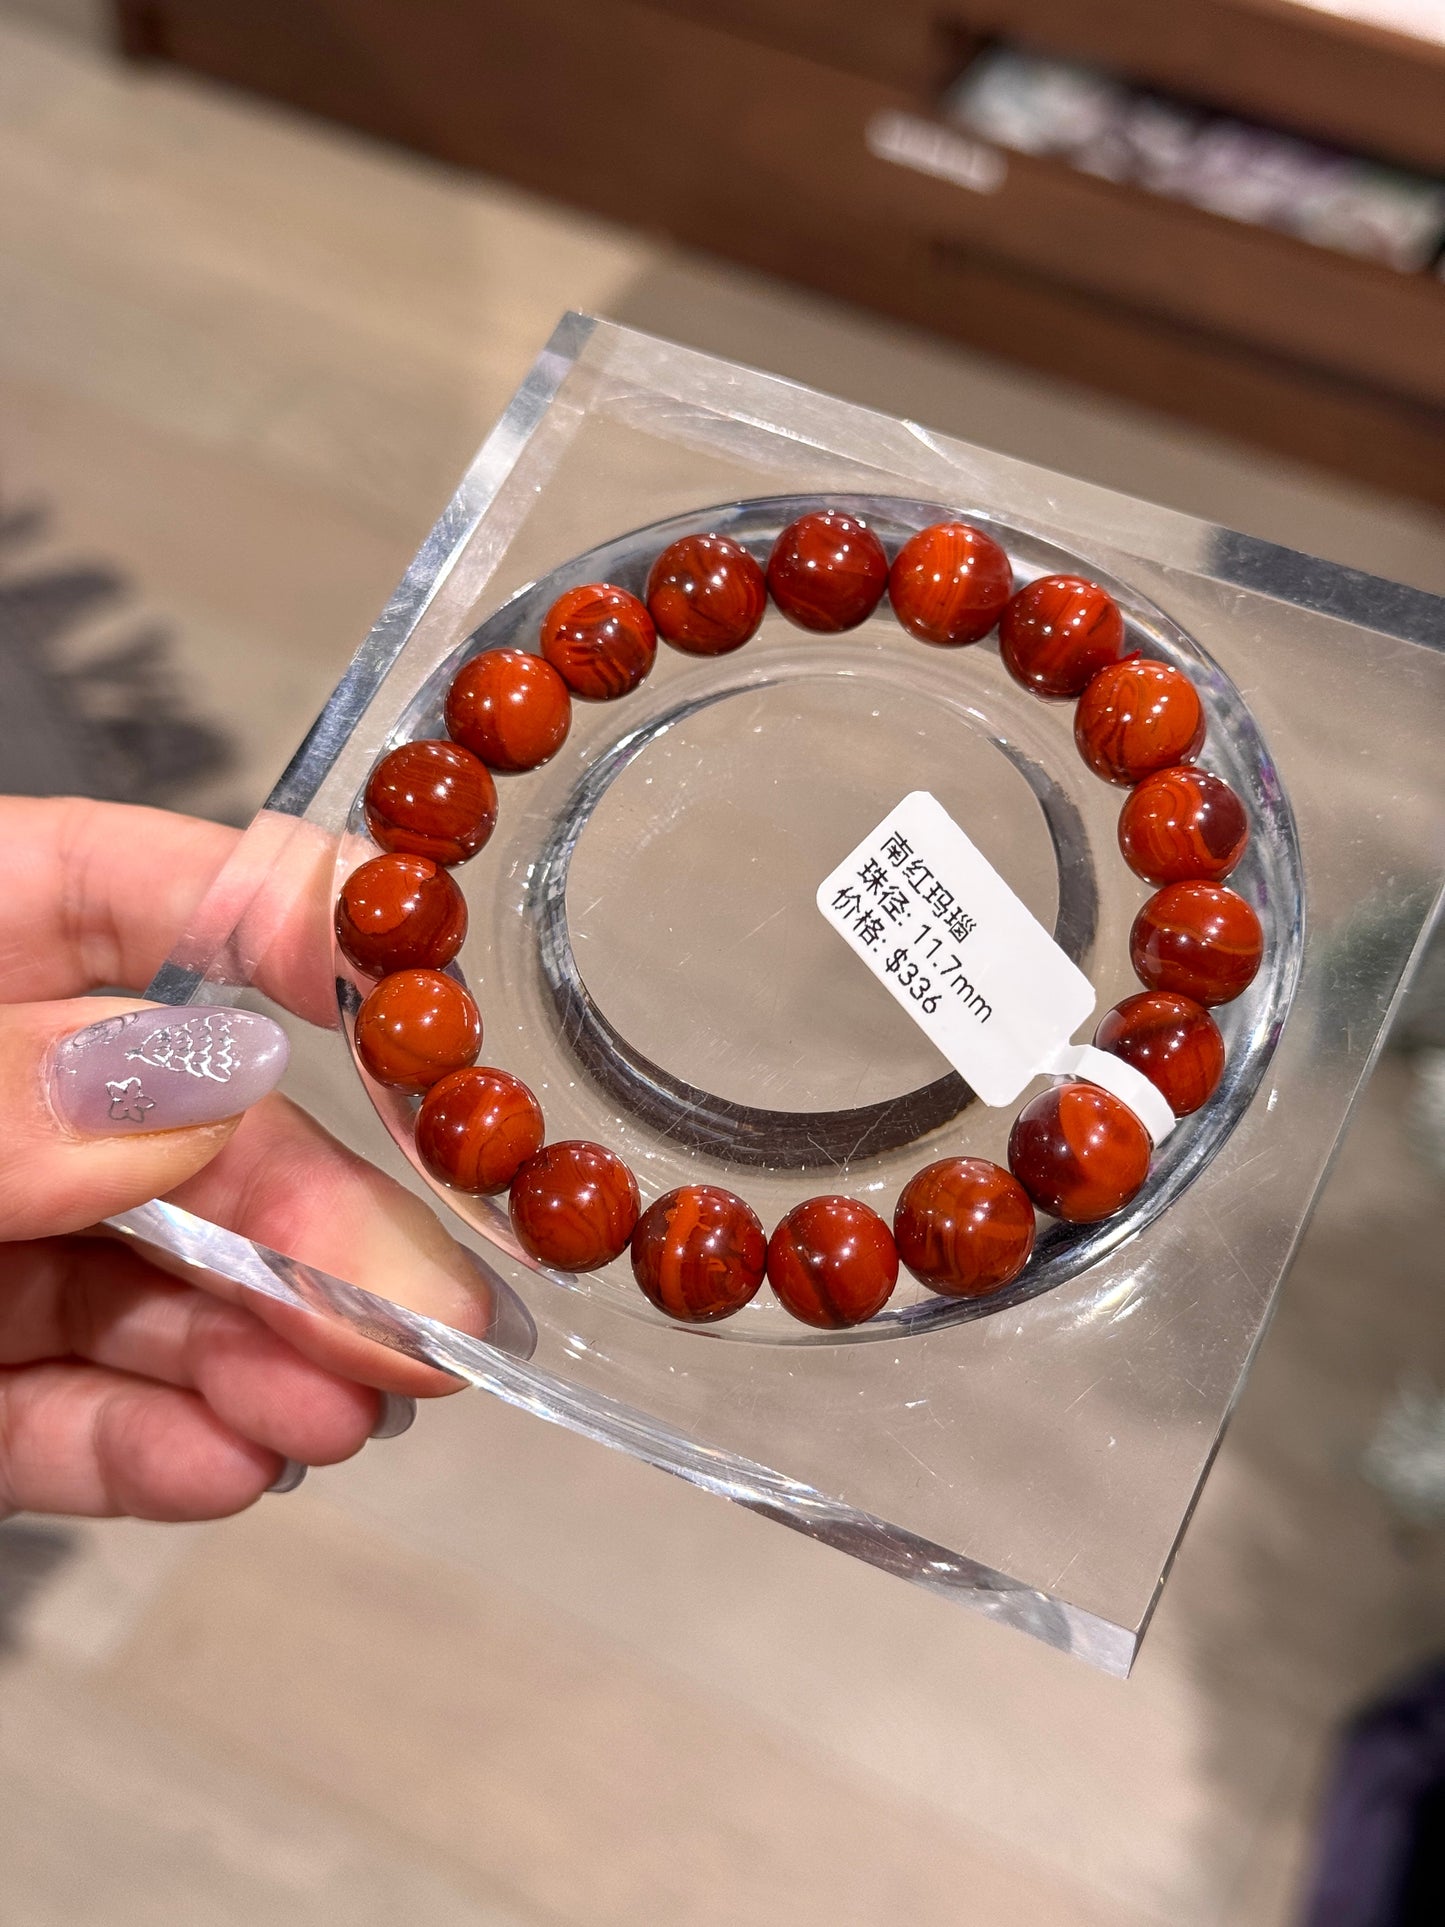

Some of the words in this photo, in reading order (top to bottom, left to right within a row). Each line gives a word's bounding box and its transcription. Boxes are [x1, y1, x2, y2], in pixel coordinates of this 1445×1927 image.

[879, 831, 977, 944] 南红玛瑙
[885, 948, 943, 1014] $336
[913, 924, 993, 1024] 11.7mm
